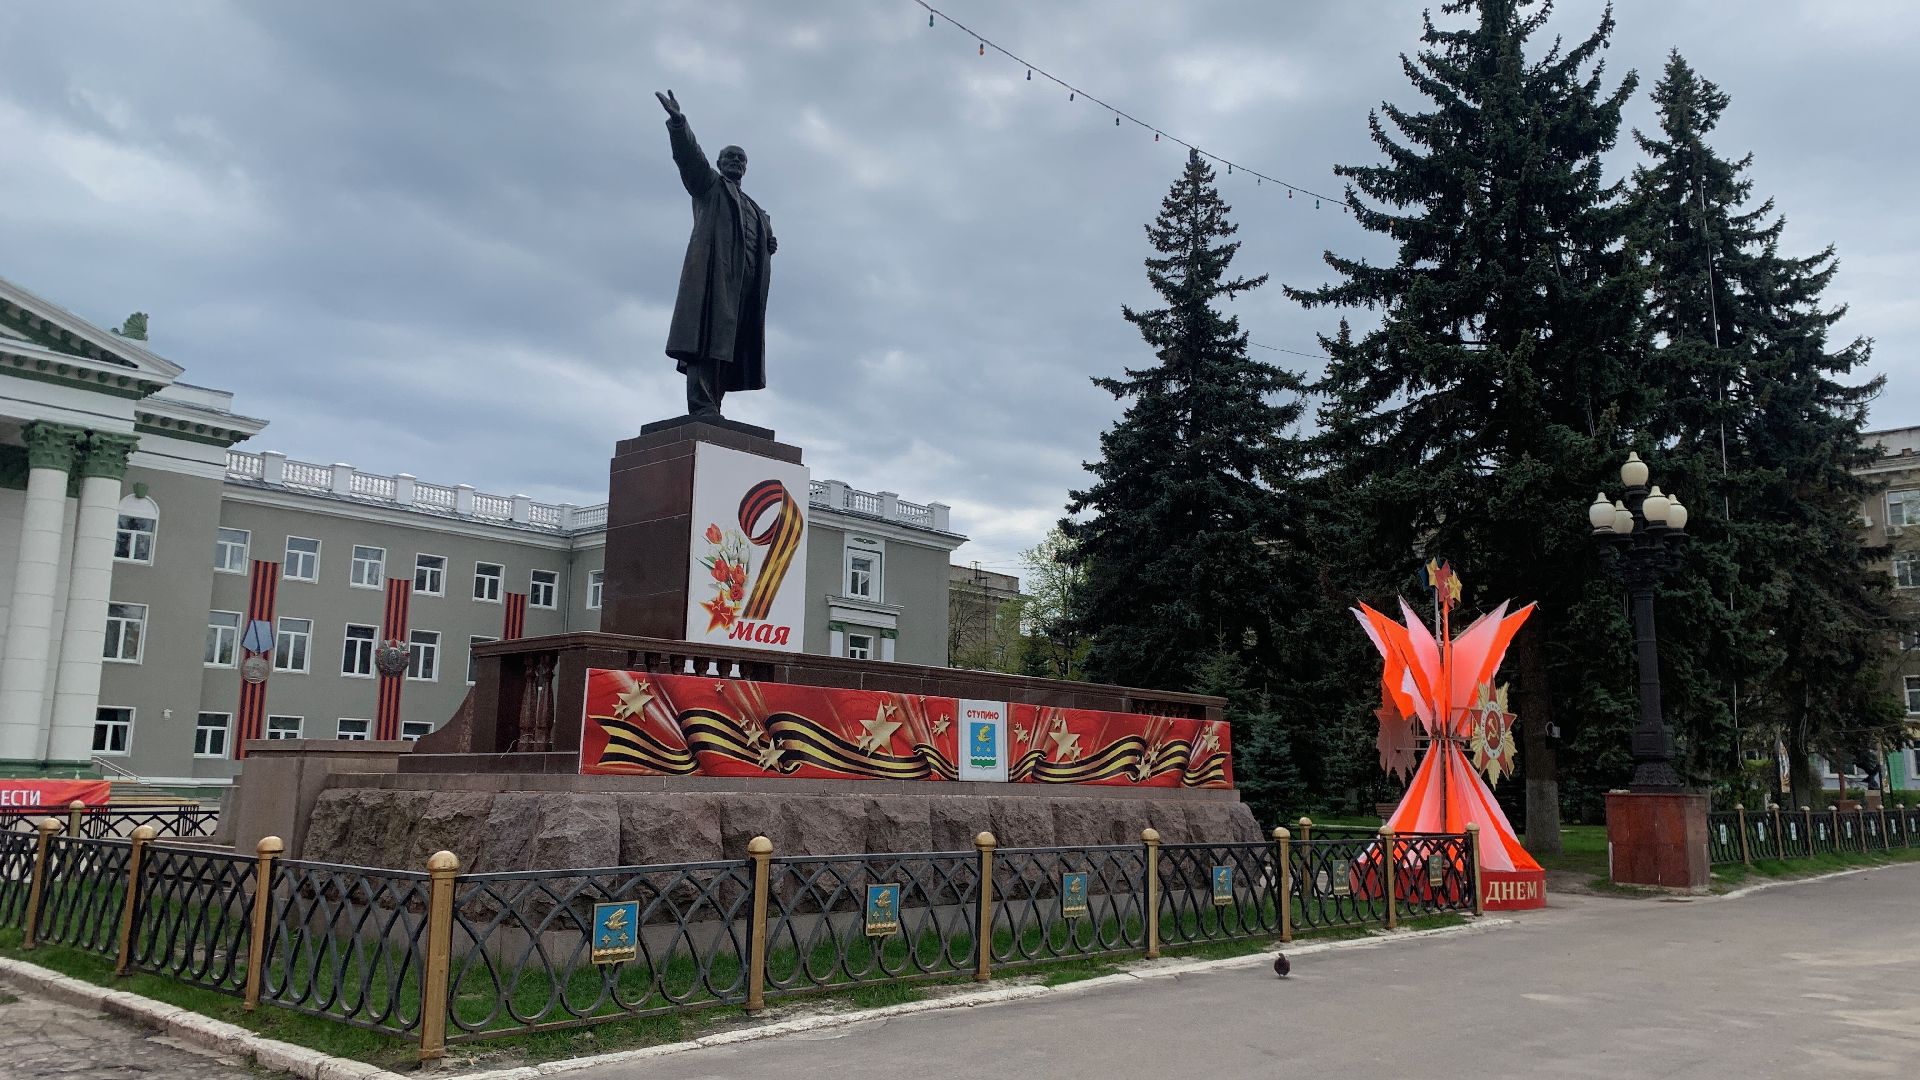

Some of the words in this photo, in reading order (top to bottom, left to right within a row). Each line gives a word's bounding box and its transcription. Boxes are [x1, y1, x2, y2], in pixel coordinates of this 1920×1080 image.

[738, 479, 804, 620] 9
[729, 620, 791, 646] мая
[967, 709, 999, 720] СТУПИНО
[1, 789, 41, 806] ЕСТИ
[1486, 881, 1538, 904] ДНЕМ
